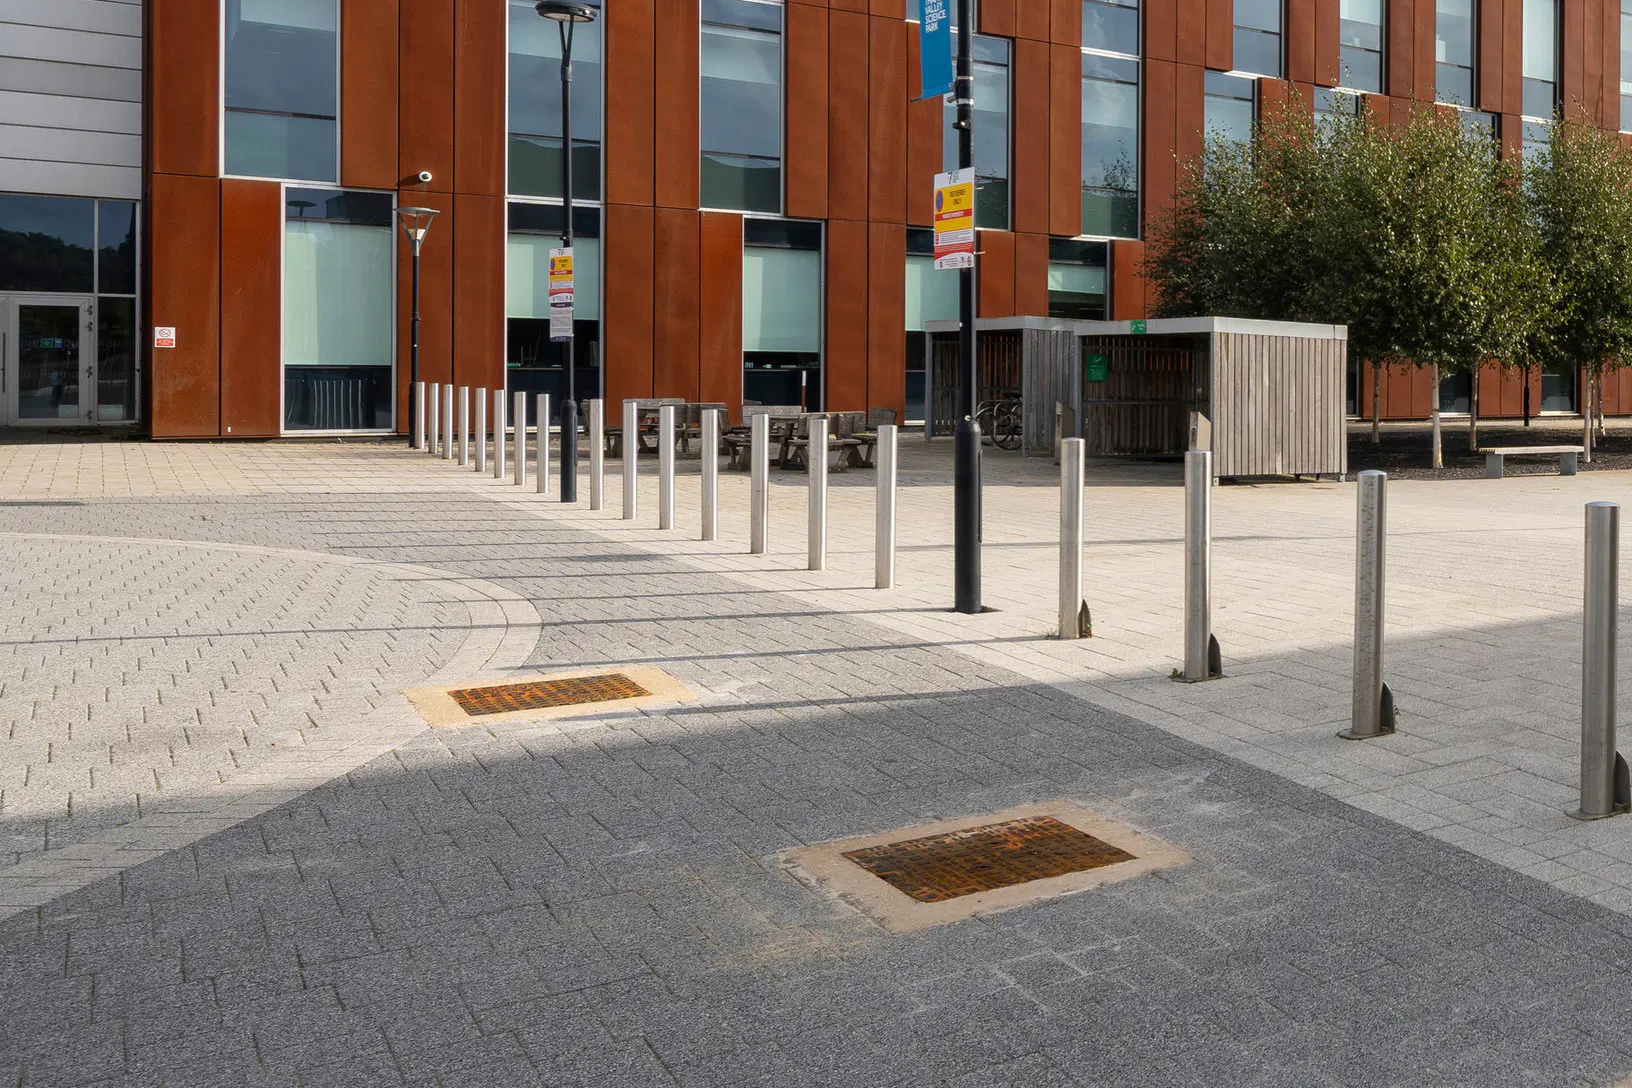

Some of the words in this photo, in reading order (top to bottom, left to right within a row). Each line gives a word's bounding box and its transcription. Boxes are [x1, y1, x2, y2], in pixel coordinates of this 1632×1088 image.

[925, 1, 943, 15] VALLEY
[925, 10, 946, 24] SCIENCE
[925, 21, 938, 33] PARK
